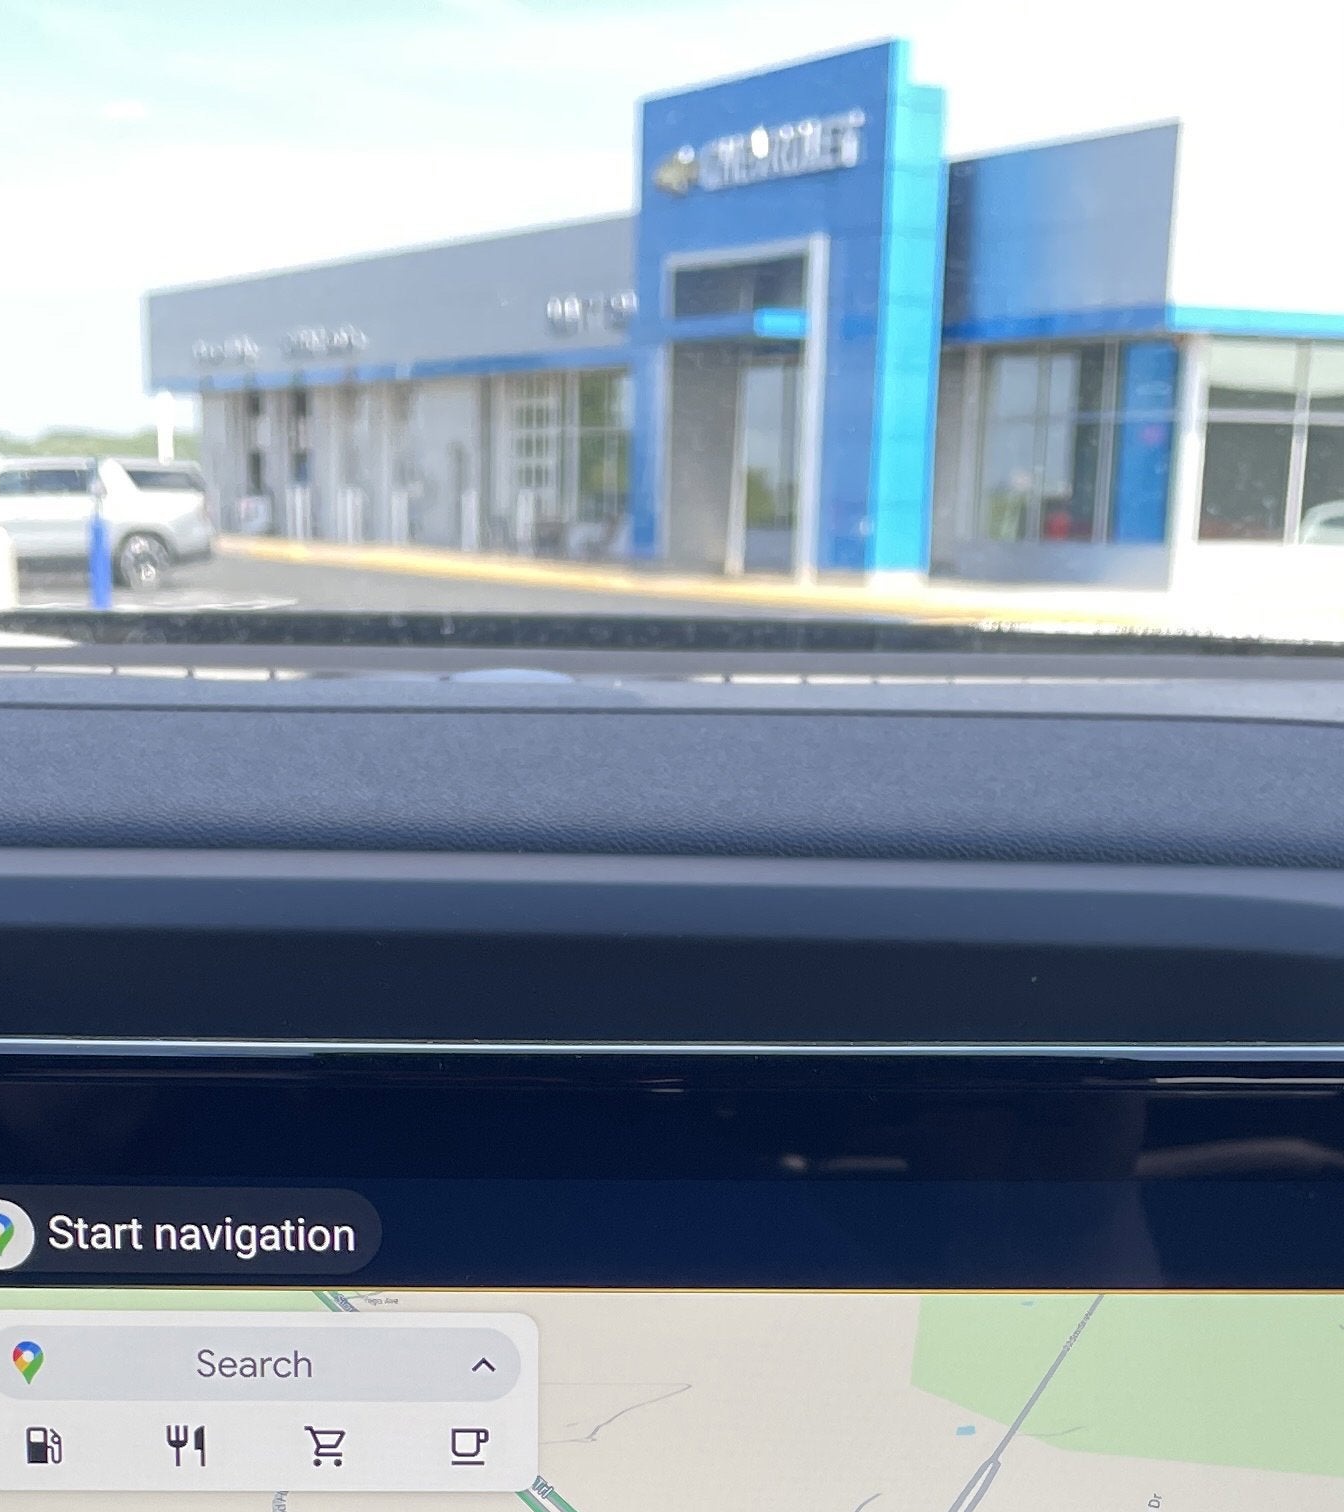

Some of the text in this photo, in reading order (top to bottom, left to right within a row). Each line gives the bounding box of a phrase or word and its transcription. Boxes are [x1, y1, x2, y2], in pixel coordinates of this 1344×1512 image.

[48, 1215, 355, 1260] Start navigation
[196, 1349, 313, 1379] Search
[1148, 1493, 1162, 1509] Dr
